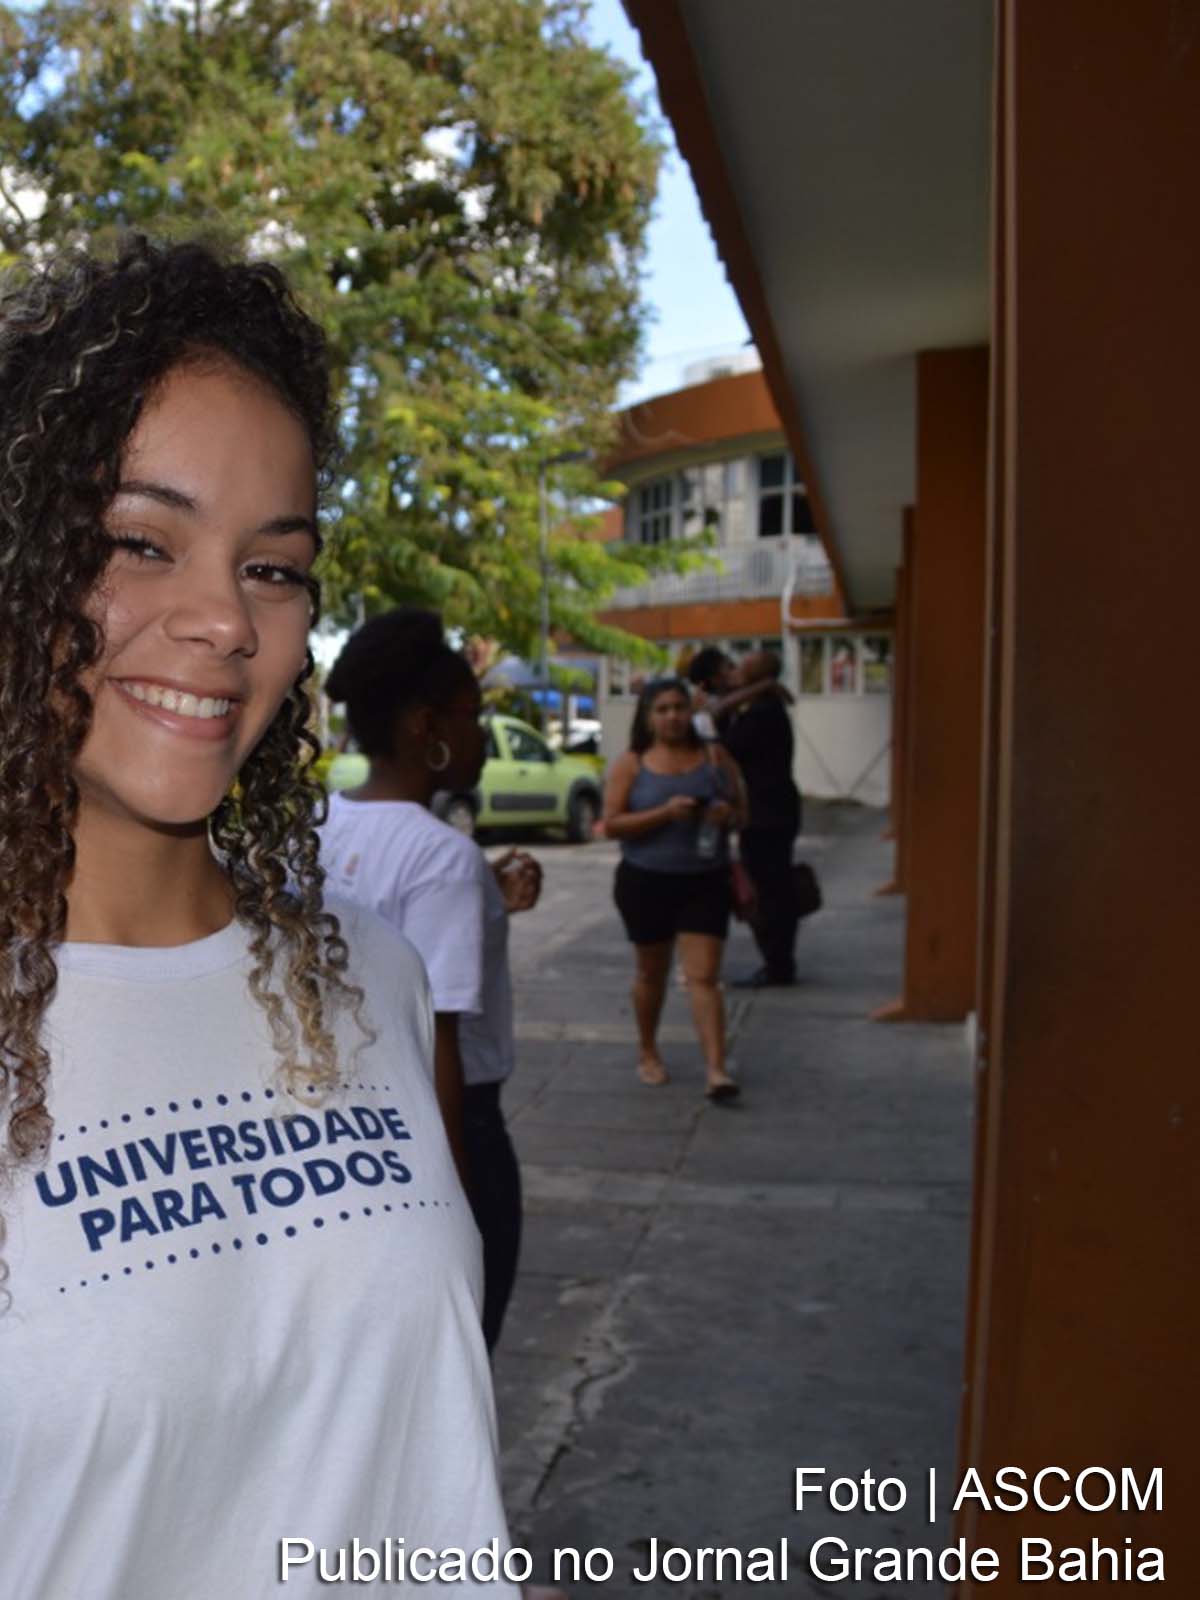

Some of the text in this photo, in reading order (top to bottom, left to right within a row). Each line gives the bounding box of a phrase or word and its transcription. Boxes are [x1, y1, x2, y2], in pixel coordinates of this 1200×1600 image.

[34, 1106, 412, 1207] UNIVERSIDADE
[80, 1149, 412, 1252] PARA TODOS
